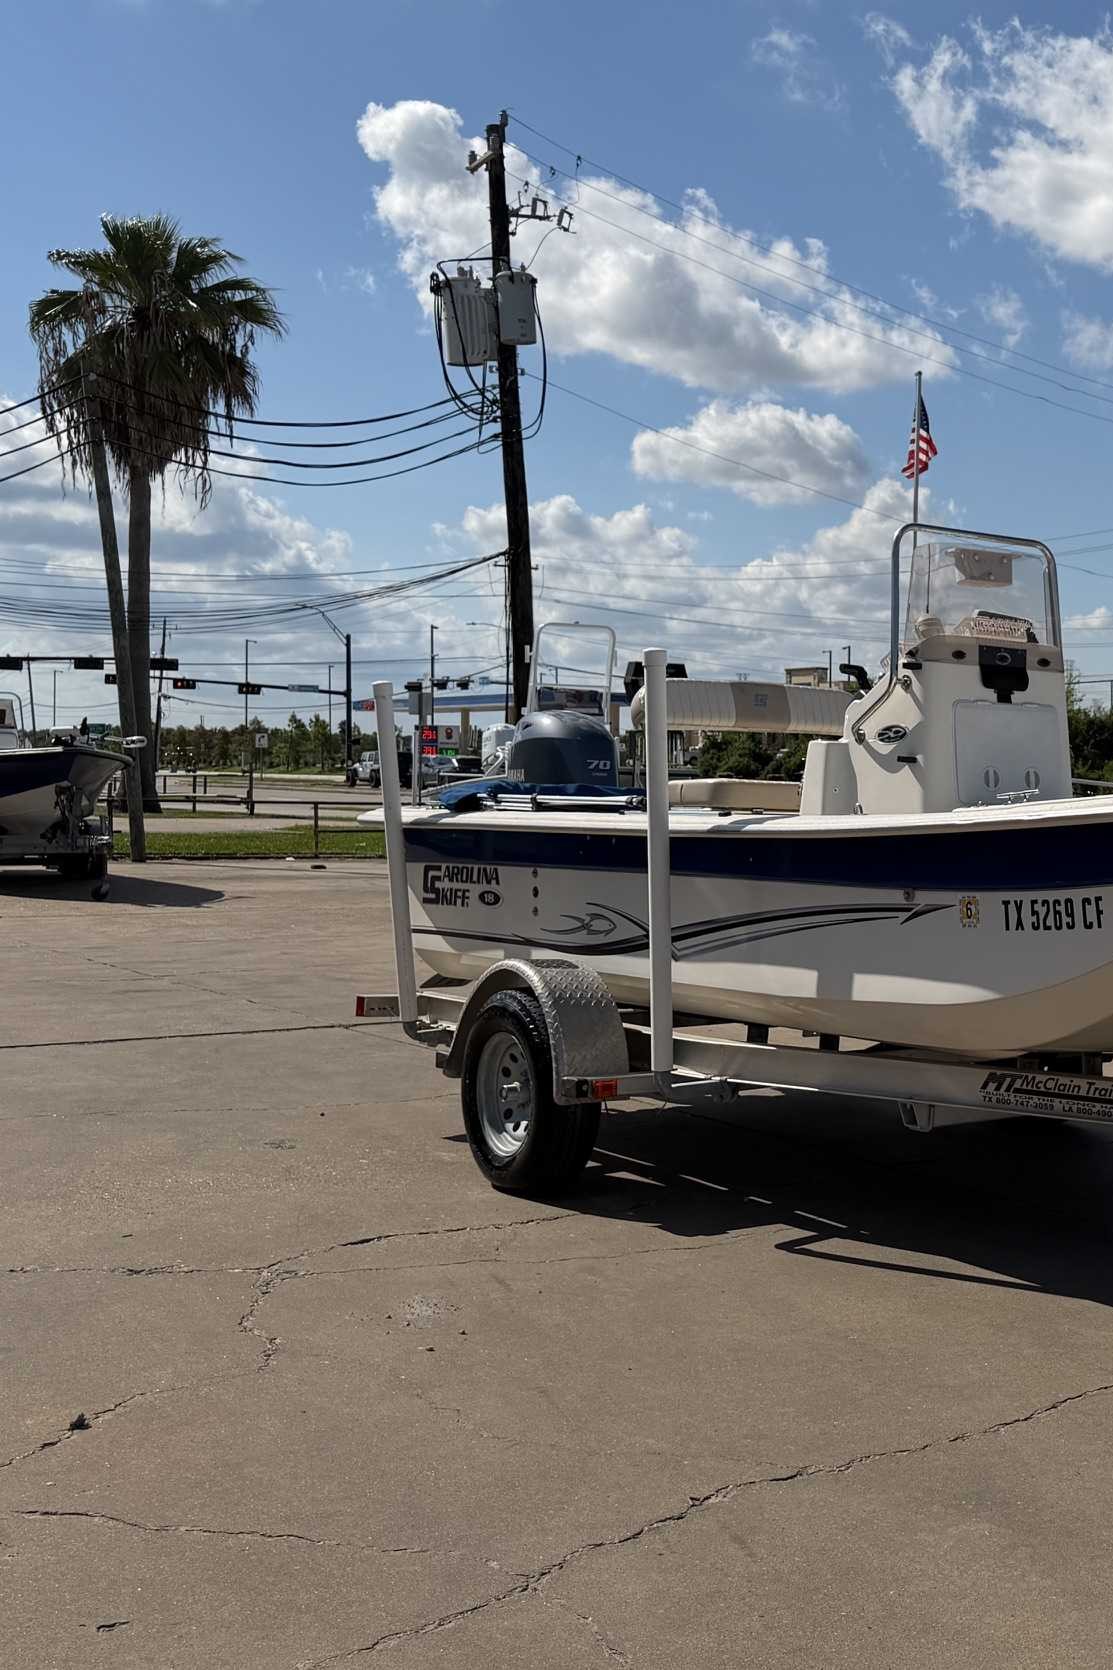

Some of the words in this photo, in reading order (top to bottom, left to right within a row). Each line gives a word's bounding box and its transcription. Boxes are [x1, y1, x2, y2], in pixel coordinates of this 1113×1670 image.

[586, 759, 611, 770] 70
[423, 864, 500, 890] CAROLINA
[423, 878, 470, 907] SKIFF
[484, 893, 495, 903] 18
[1001, 900, 1025, 931] TX
[1030, 897, 1075, 931] 5269
[1081, 896, 1104, 930] CF
[1020, 1074, 1081, 1096] McClain
